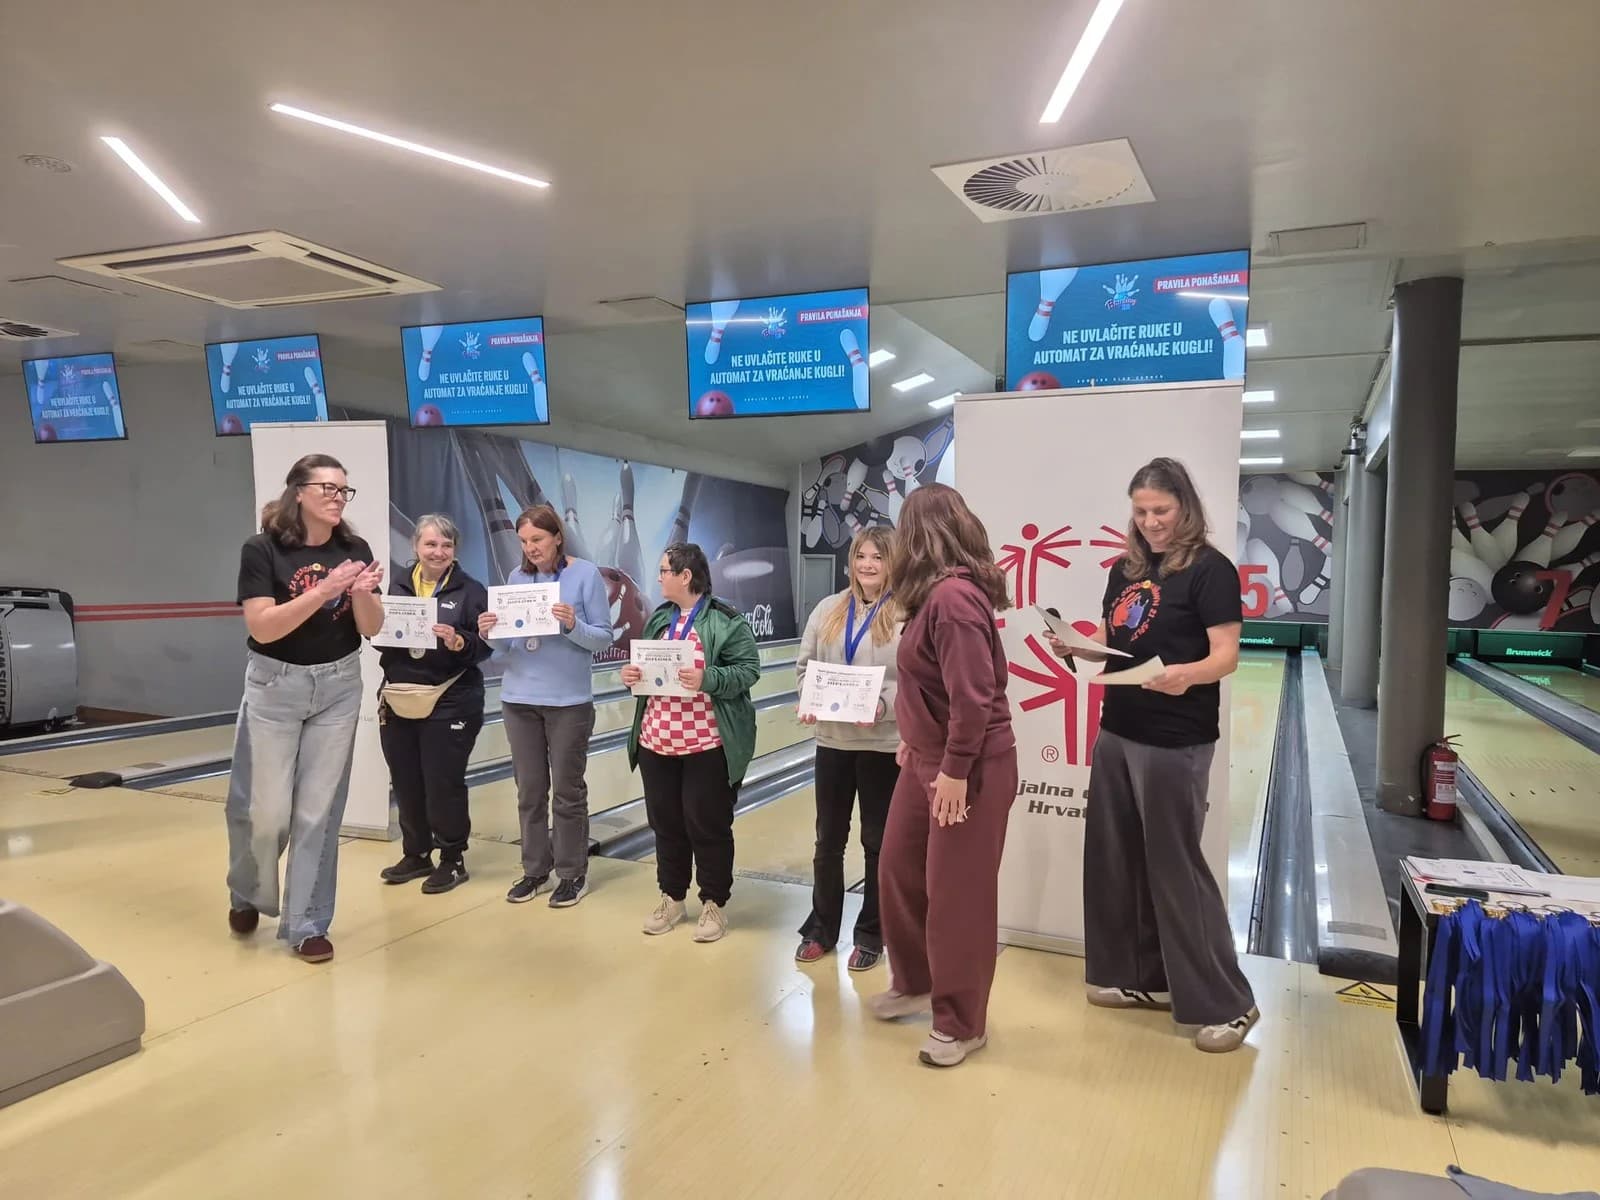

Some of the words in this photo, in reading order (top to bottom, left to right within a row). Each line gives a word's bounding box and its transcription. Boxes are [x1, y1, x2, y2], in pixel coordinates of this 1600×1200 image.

[1157, 277, 1191, 291] PRAVILA
[1063, 329, 1079, 345] NE
[1081, 323, 1137, 342] UVLAČITE
[1139, 323, 1171, 339] RUKE
[1174, 322, 1183, 336] U
[731, 355, 744, 368] NE
[744, 351, 788, 366] UVLAČITE
[788, 351, 813, 363] RUKE
[814, 350, 821, 362] U
[1033, 348, 1089, 365] AUTOMAT
[1089, 347, 1105, 361] ZA
[1106, 341, 1170, 359] VRAĆANJE
[1172, 339, 1213, 355] KUGLI!
[440, 373, 449, 384] NE
[449, 369, 483, 384] UVLAČITE
[483, 370, 503, 381] RUKE
[504, 370, 509, 380] U
[710, 371, 750, 385] AUTOMAT
[752, 370, 764, 382] ZA
[765, 366, 813, 381] VRAĆANJE
[814, 365, 845, 378] KUGLI!
[424, 387, 455, 399] AUTOMAT
[456, 386, 466, 397] ZA
[466, 383, 504, 397] VRAĆANJE
[504, 384, 528, 395] KUGLI!
[1239, 565, 1268, 617] 5
[1535, 569, 1573, 629] 7
[1505, 647, 1553, 657] Brunswick
[1017, 780, 1074, 798] jalna
[1028, 800, 1087, 818] Hrvat
